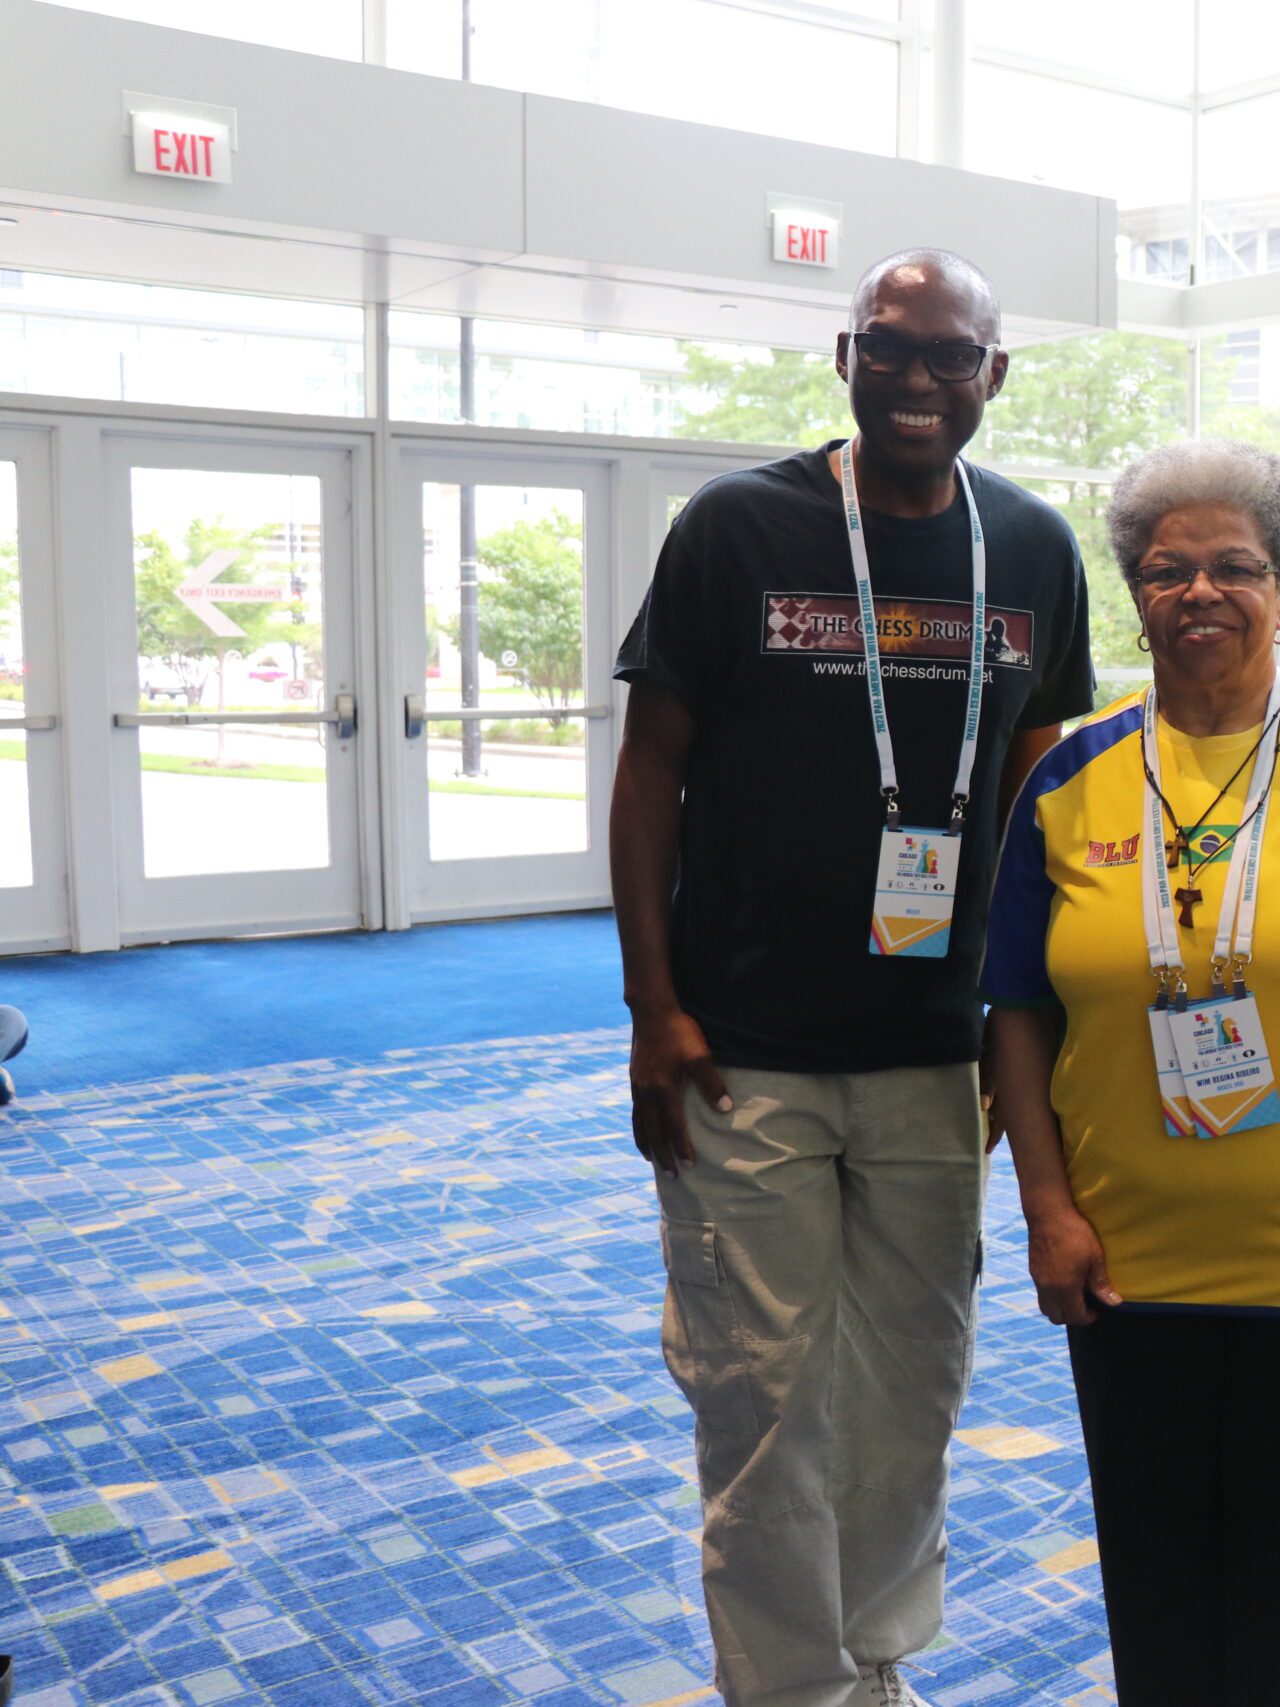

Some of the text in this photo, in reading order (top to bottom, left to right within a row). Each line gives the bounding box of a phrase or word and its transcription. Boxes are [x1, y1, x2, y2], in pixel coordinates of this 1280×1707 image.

[154, 129, 215, 177] EXIT
[788, 224, 829, 263] EXIT
[976, 592, 984, 609] 2023
[810, 616, 848, 634] THE
[920, 622, 974, 640] DRUM
[974, 610, 984, 662] PAN-AMERICAN
[858, 579, 886, 733] 2023 PAN-AMERICAN YOUTH CHESS FESTIVAL
[813, 662, 994, 683] www.thchessdrum.et
[966, 710, 979, 742] FESTIVAL
[1251, 803, 1265, 841] AN-AMERICAN
[1086, 833, 1140, 863] BLU
[1196, 1067, 1260, 1087] WIM REGINA RIBEIRO
